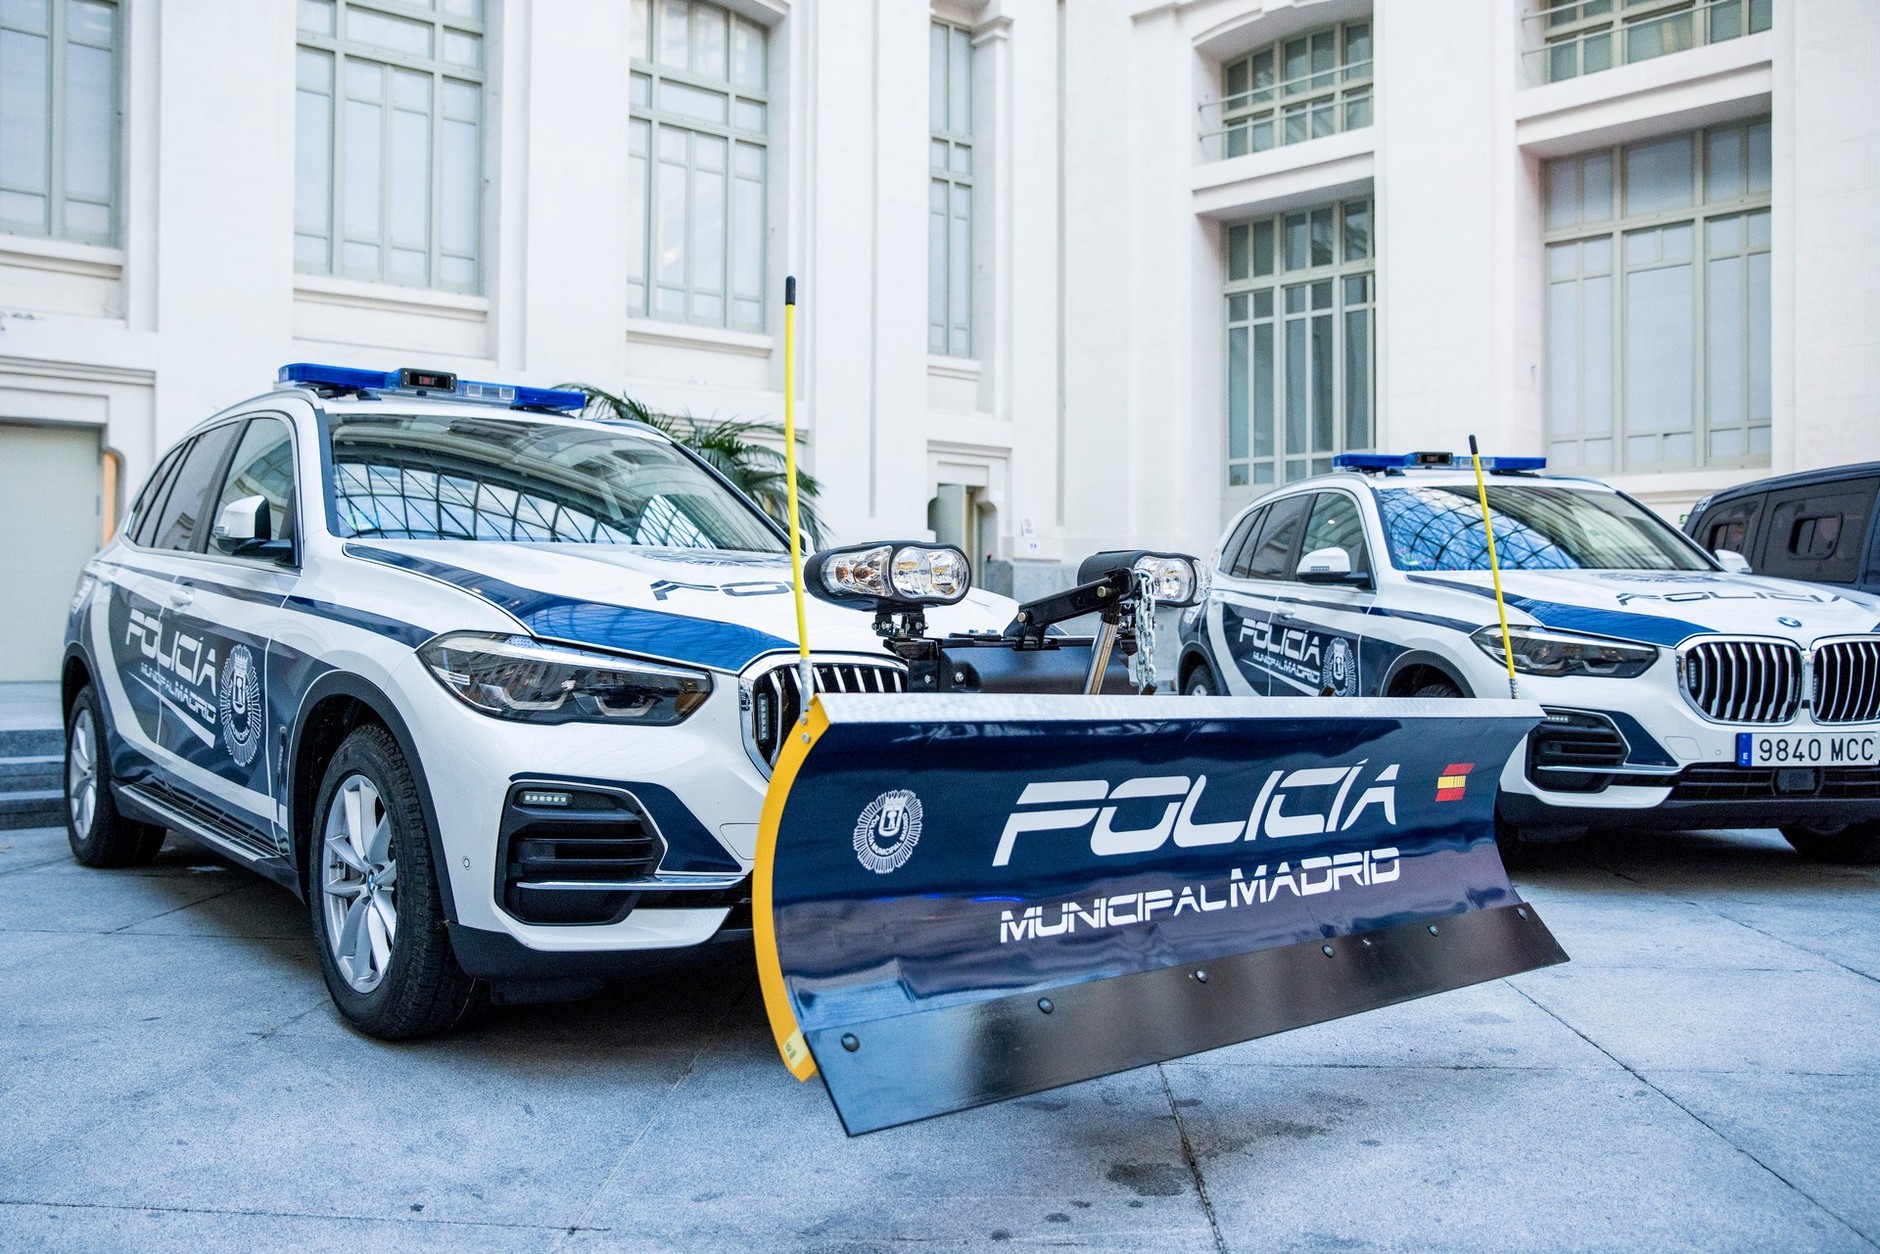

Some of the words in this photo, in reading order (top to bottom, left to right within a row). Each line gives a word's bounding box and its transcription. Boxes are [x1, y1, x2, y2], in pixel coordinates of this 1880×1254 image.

[125, 608, 217, 696] POLICÍA
[1239, 617, 1320, 667] POLICÍA
[1283, 660, 1321, 684] MADRID
[174, 679, 217, 725] MADRID
[1742, 752, 1749, 760] E
[1759, 738, 1821, 762] 9840
[1831, 738, 1874, 762] MCC
[992, 758, 1400, 867] POLICÍA
[1000, 884, 1227, 944] MUNICIPAL
[1230, 847, 1400, 908] MADRID
